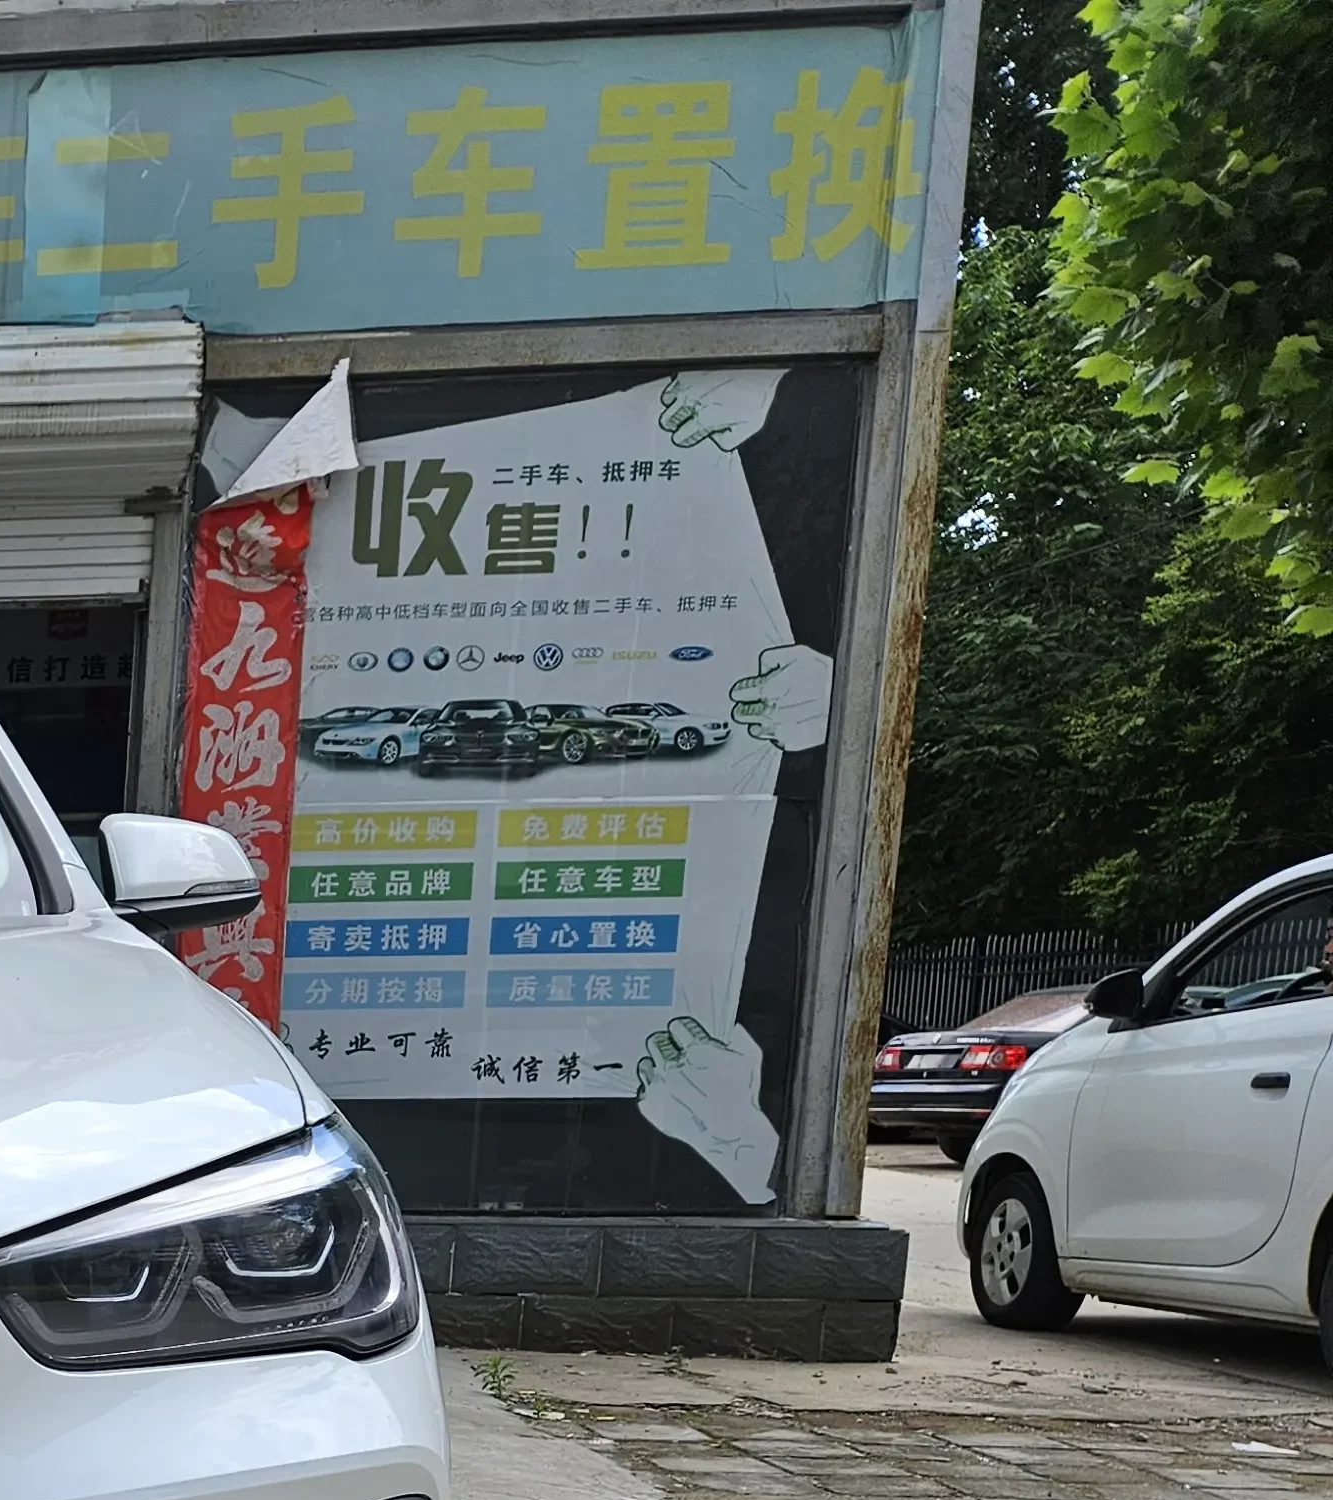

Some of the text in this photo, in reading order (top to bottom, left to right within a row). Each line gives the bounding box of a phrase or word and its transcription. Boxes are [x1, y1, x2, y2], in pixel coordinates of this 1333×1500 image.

[492, 459, 681, 486] 二手车、抵押车
[493, 650, 525, 665] Jeep
[612, 650, 658, 661] ISUZU
[314, 817, 456, 846] 高价收购
[520, 811, 667, 842] 免费评估
[311, 867, 452, 899] 任意品牌
[518, 863, 663, 895] 任意车型
[307, 923, 448, 953] 寄卖抵押
[513, 920, 657, 950] 省心置换
[304, 977, 444, 1005] 分期按揭
[509, 973, 652, 1004] 质量保证
[307, 1027, 453, 1061] 专业可靠
[471, 1053, 624, 1086] 诚信第一
